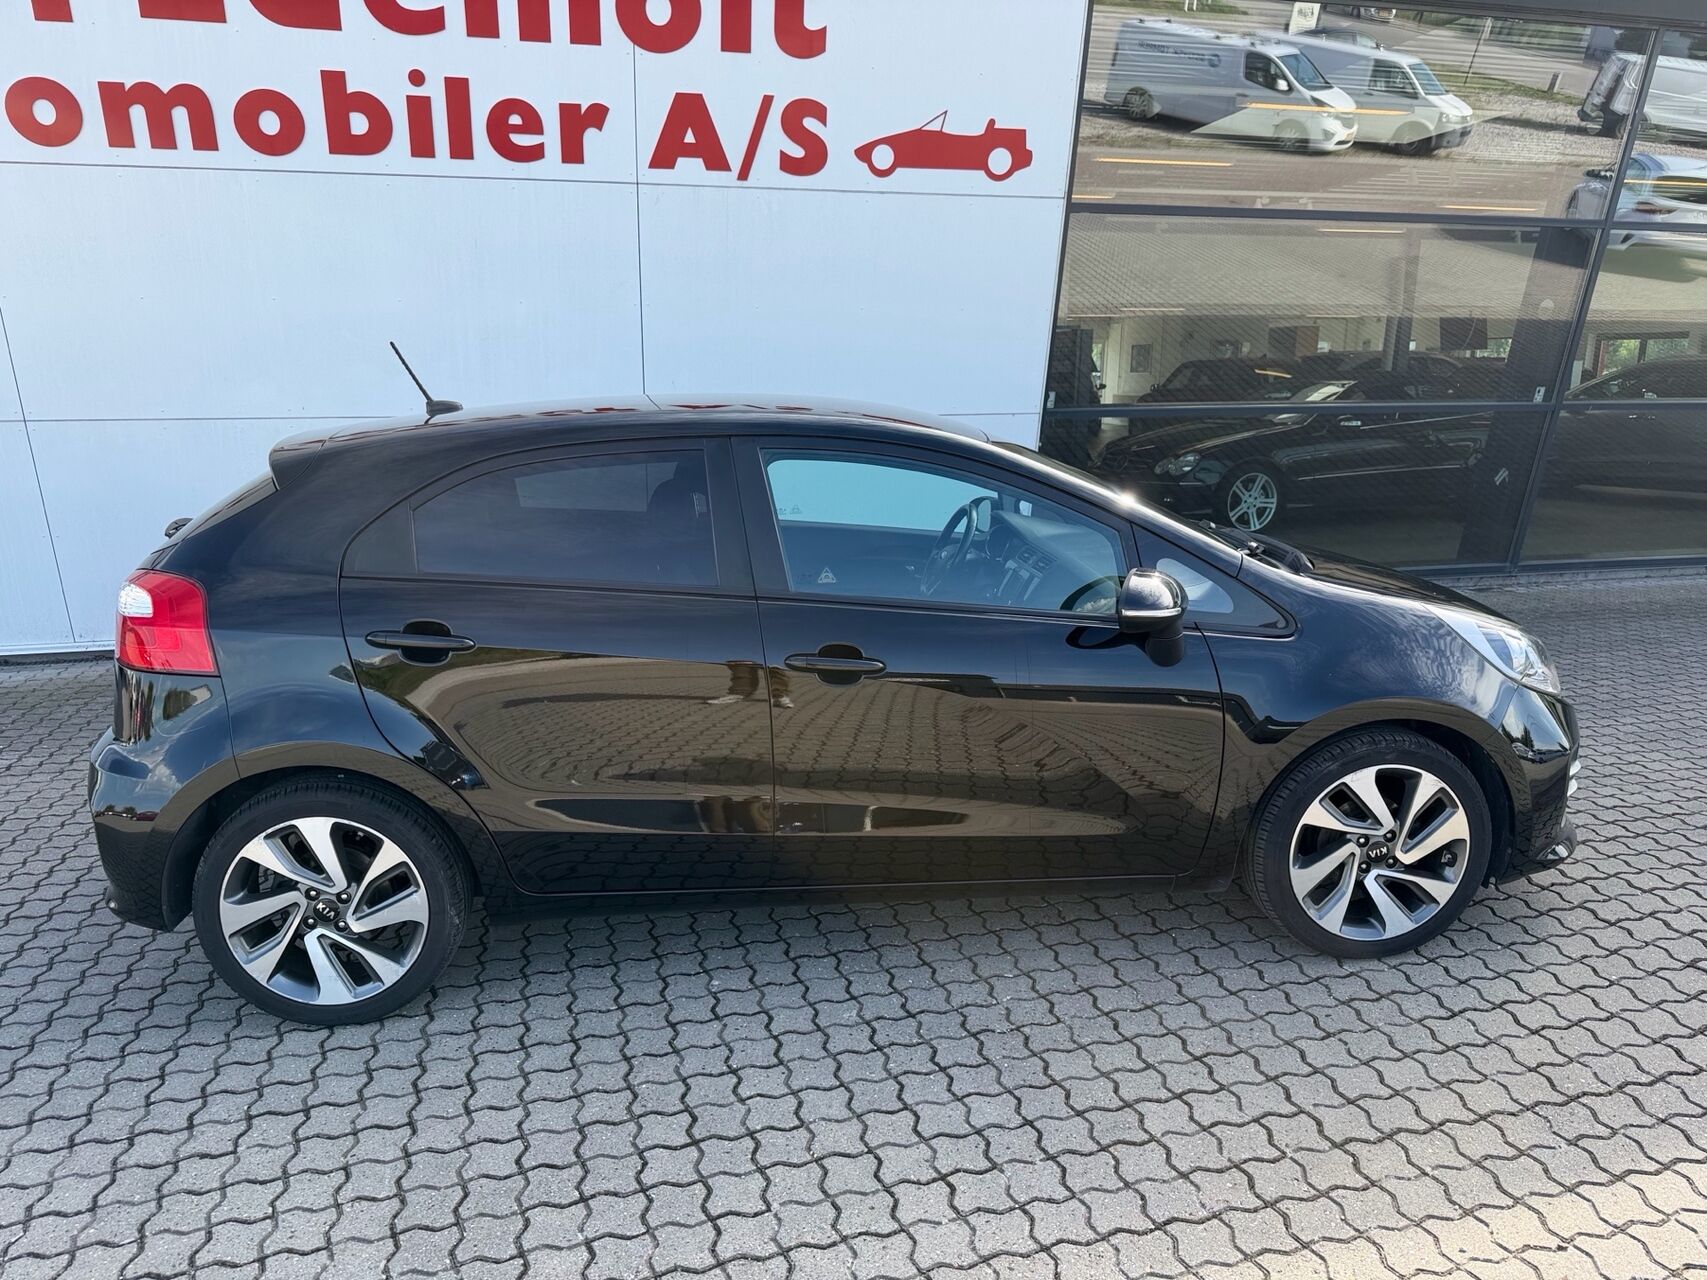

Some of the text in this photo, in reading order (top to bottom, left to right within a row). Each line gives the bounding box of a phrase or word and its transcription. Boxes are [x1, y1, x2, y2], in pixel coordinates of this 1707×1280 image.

[5, 69, 828, 180] omobiler A/S
[1368, 846, 1388, 858] KIA
[316, 902, 335, 920] KIA
